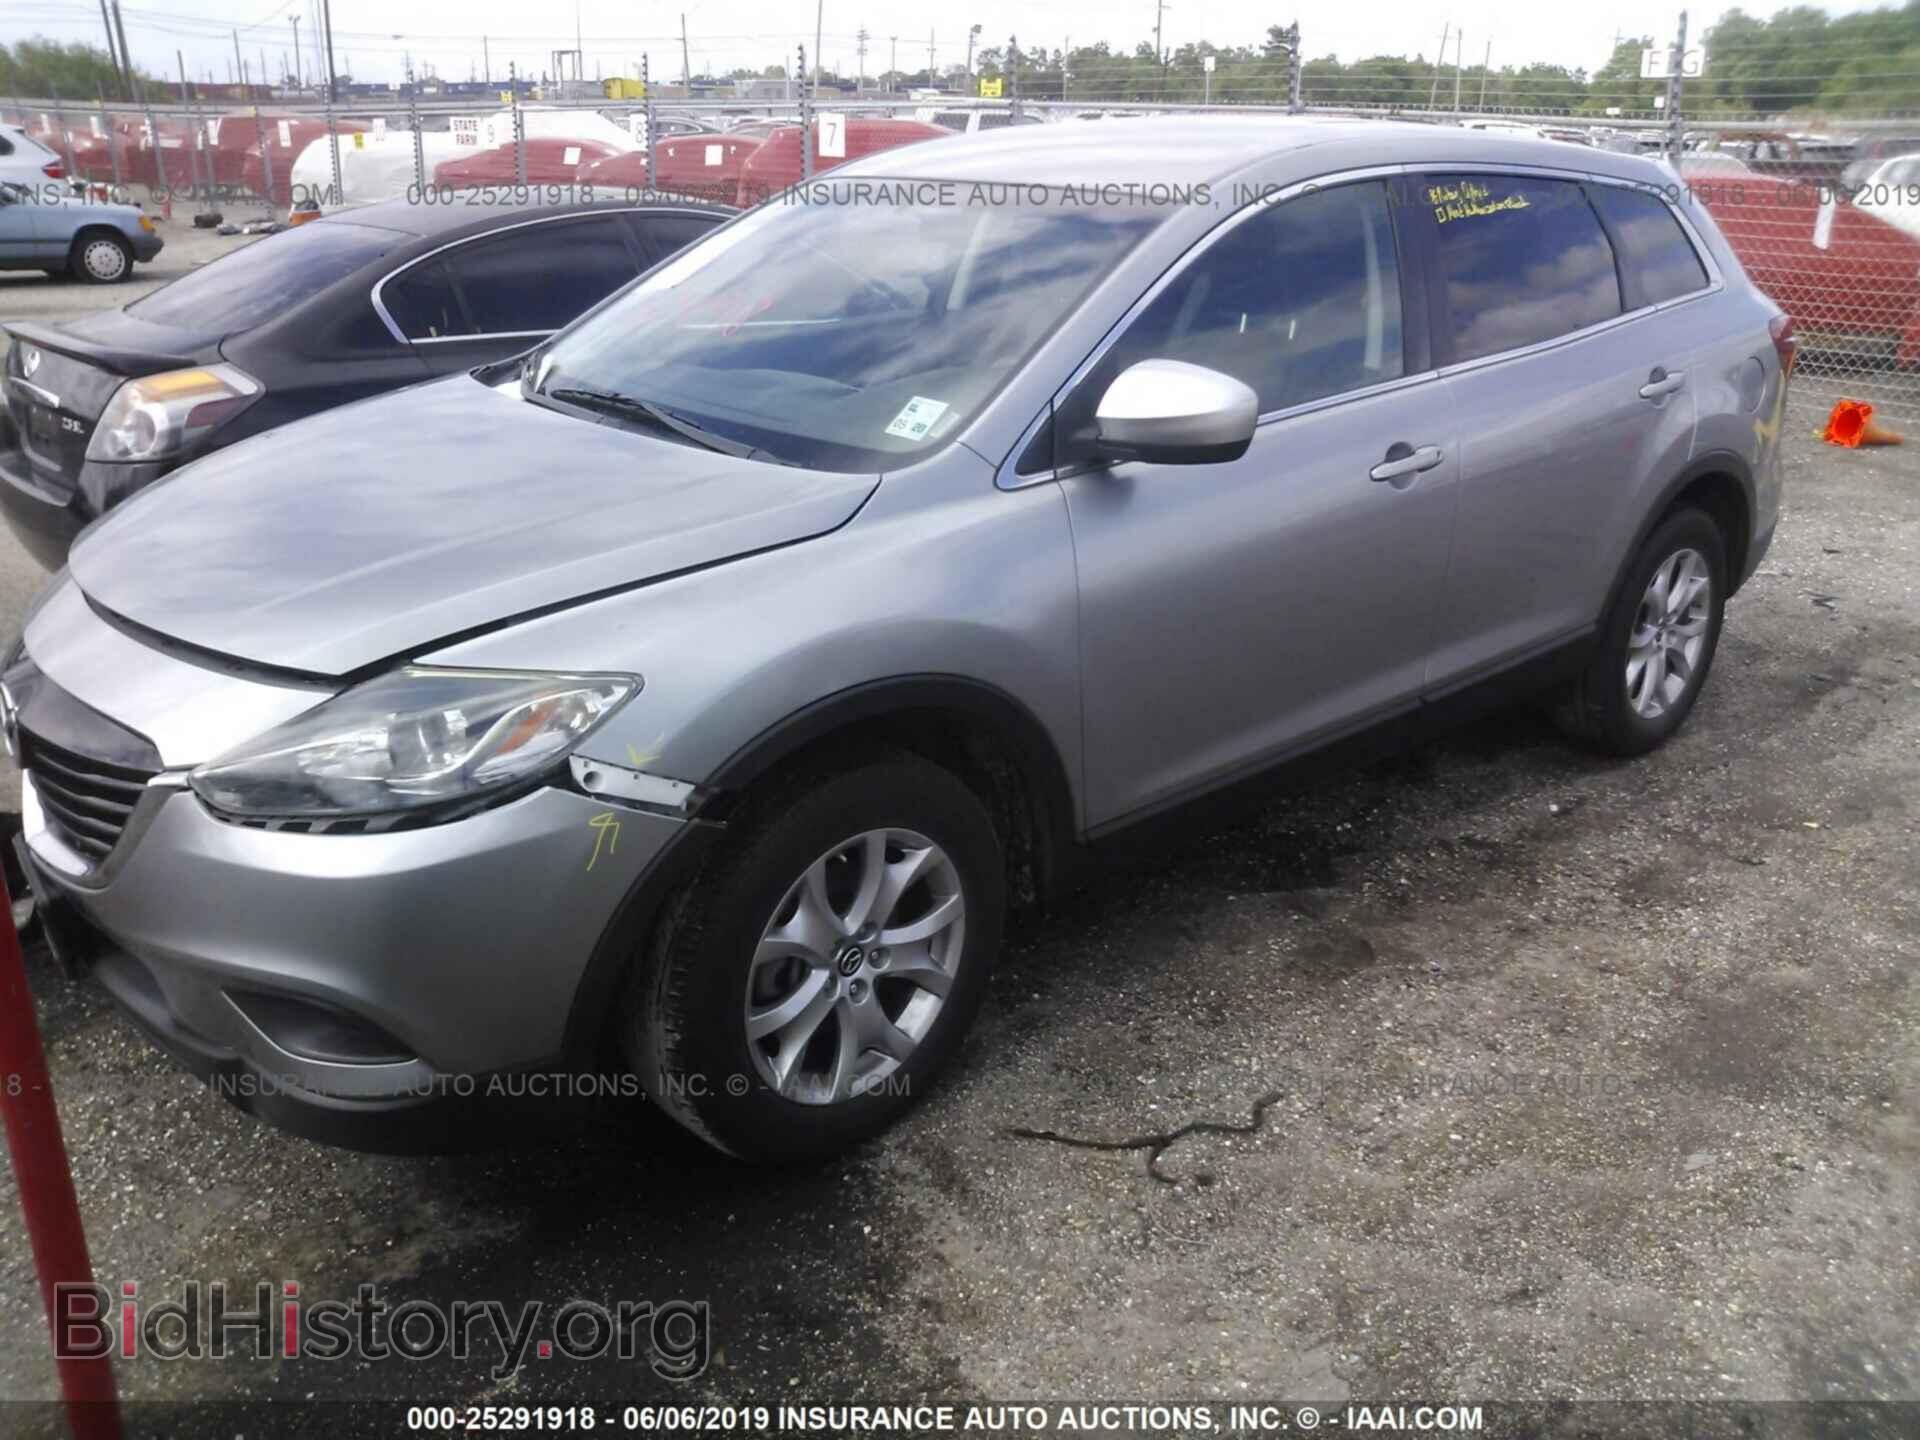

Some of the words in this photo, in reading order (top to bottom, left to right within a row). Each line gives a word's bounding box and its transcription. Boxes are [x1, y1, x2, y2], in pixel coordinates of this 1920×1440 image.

[1648, 50, 1663, 76] F
[1680, 49, 1699, 75] G
[453, 119, 478, 131] STATE
[456, 133, 478, 145] FARM
[826, 122, 837, 148] 7
